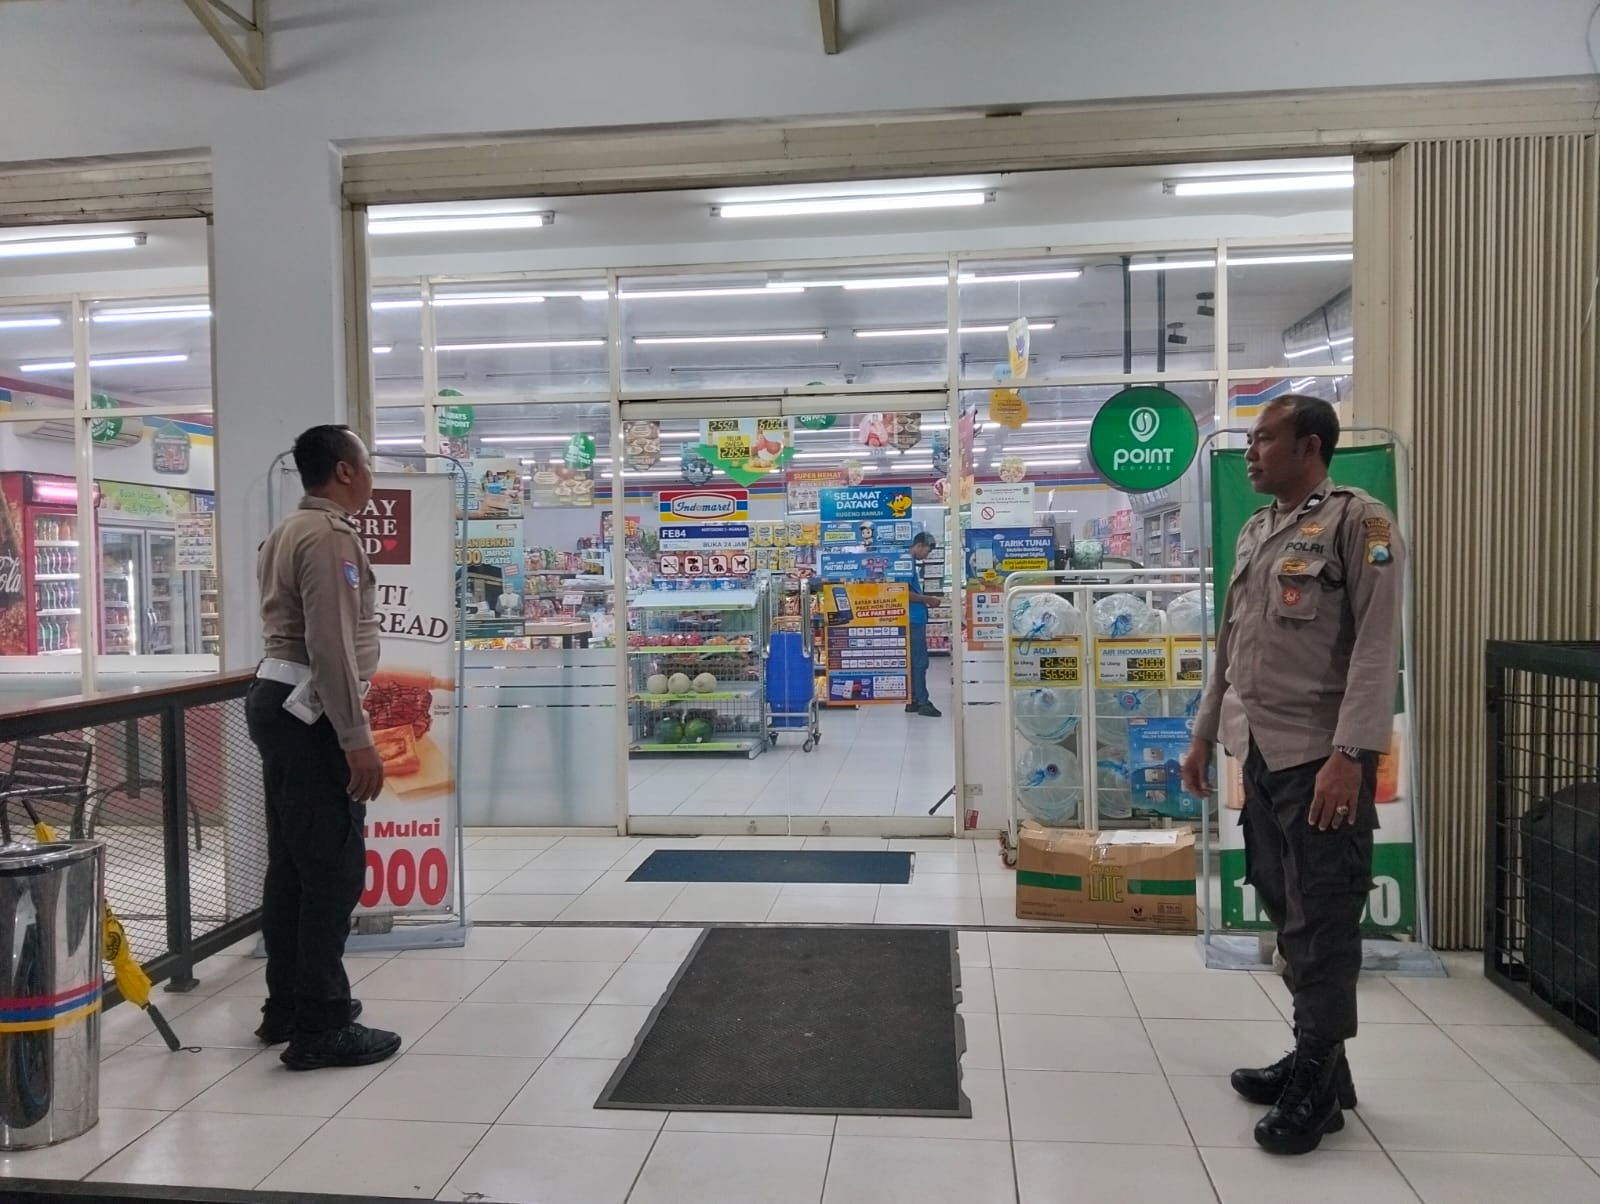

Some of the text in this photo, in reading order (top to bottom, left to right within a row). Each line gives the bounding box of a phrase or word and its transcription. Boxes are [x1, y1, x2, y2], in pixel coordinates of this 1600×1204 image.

[1113, 448, 1174, 471] POINT
[834, 491, 881, 501] SELAMAT
[675, 501, 732, 512] Indomaret
[837, 500, 879, 510] DATANG
[662, 530, 687, 538] FE84
[1285, 542, 1324, 554] POLRI
[1033, 648, 1058, 656] AQUA
[374, 818, 440, 838] Mulai
